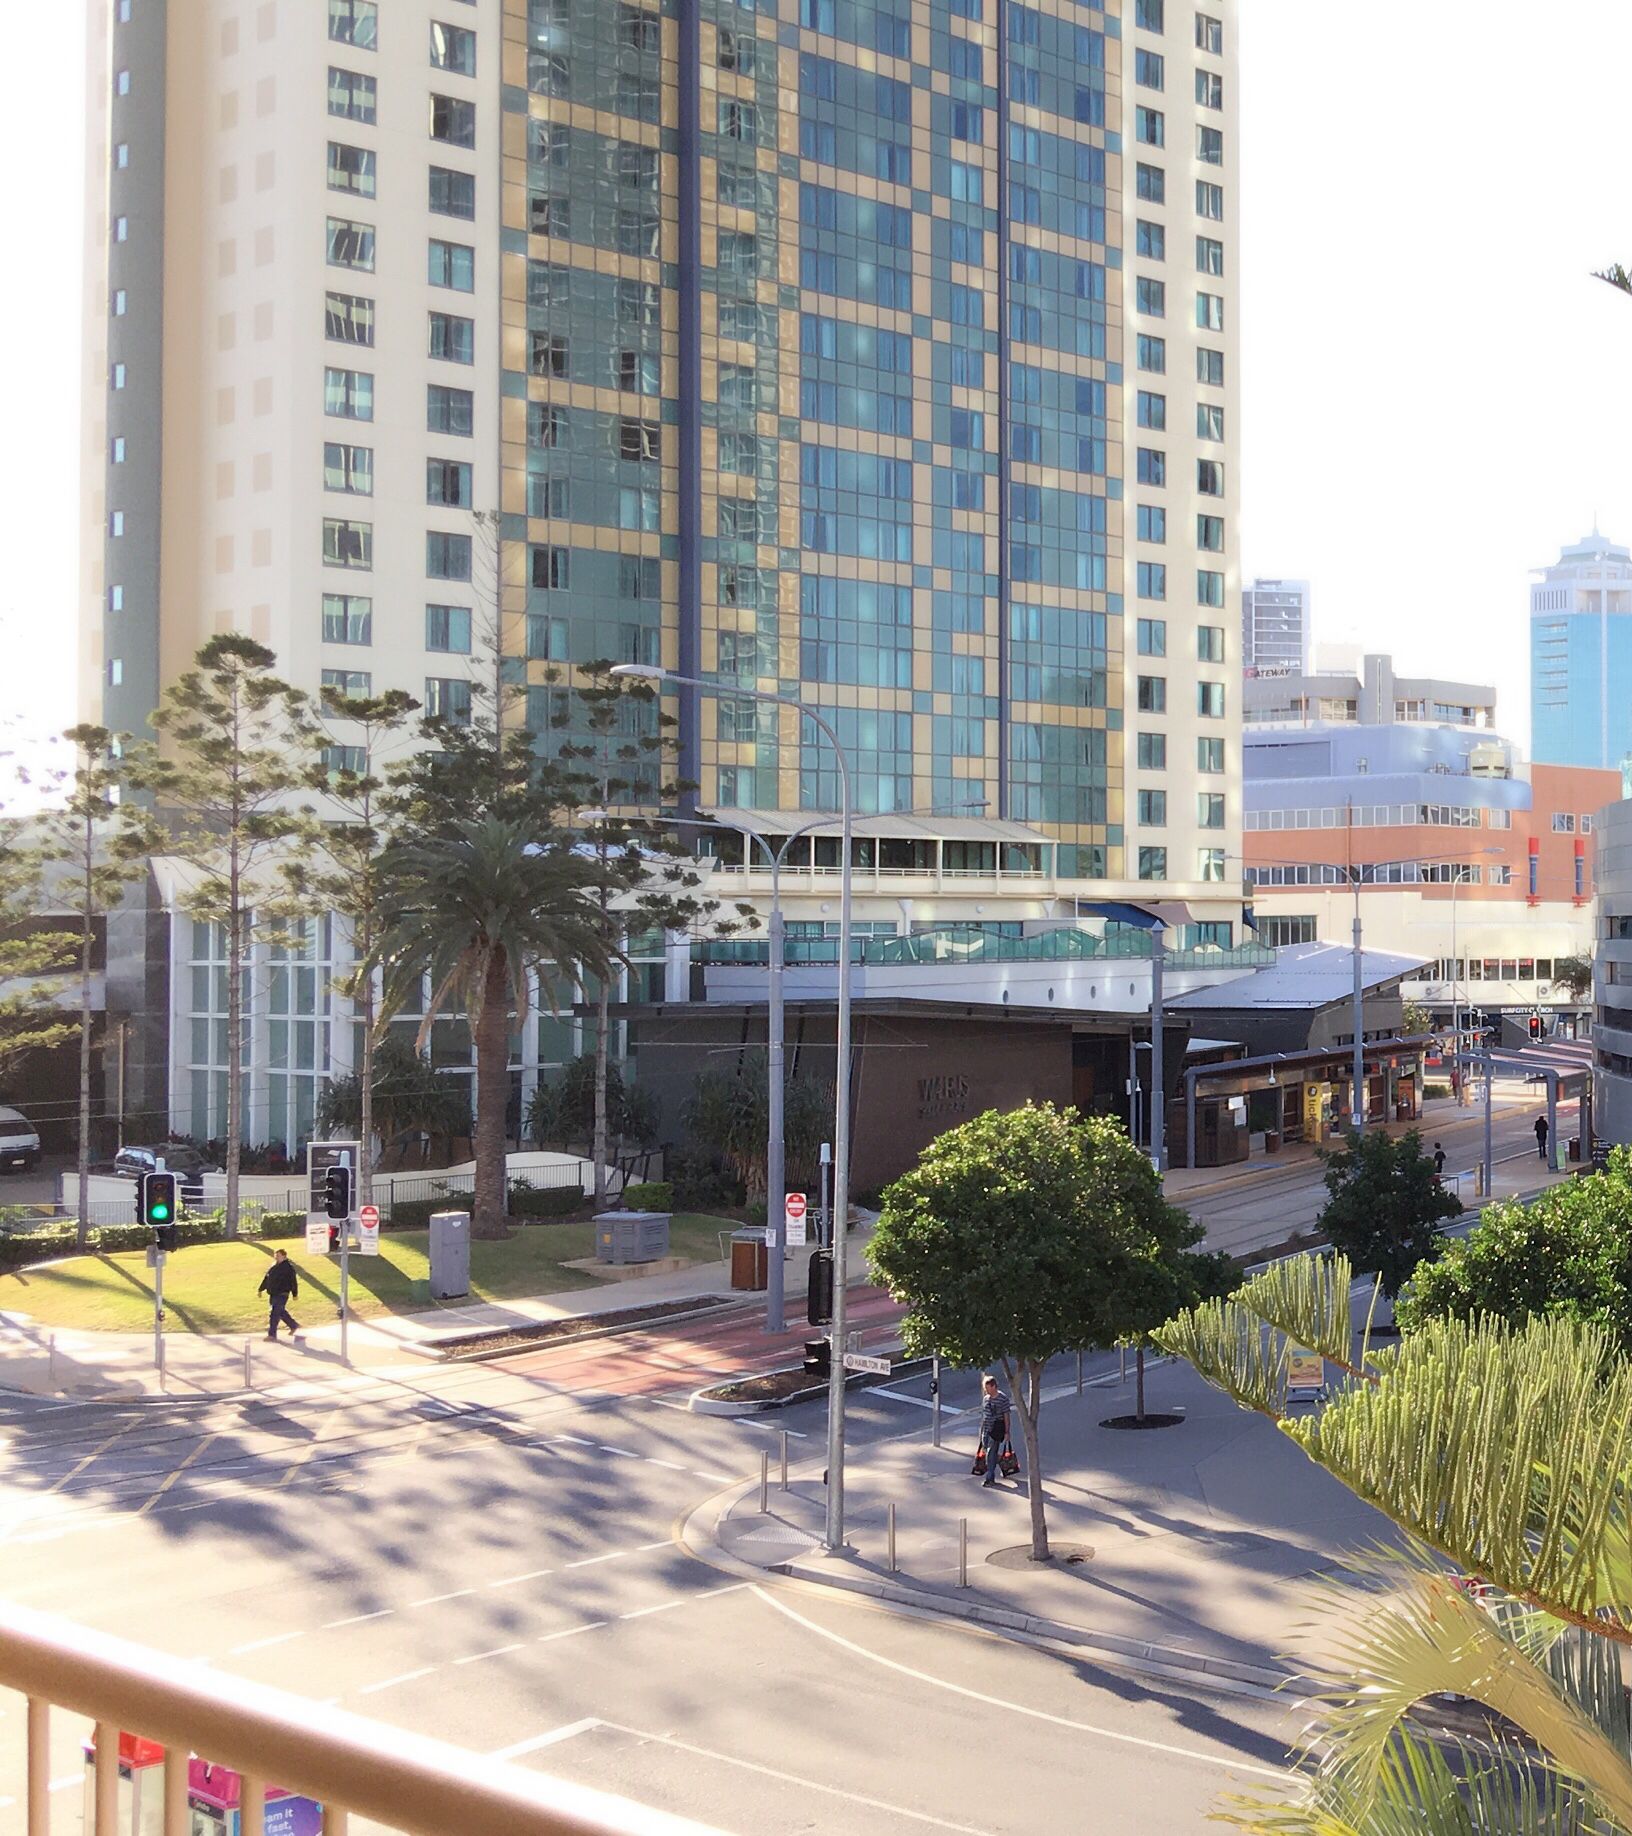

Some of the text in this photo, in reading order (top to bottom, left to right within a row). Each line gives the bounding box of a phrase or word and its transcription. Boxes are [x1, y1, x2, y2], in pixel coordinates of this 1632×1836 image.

[1243, 666, 1291, 678] GATEWAY
[1529, 1006, 1553, 1014] CRCH
[855, 1358, 878, 1370] HAMILTON
